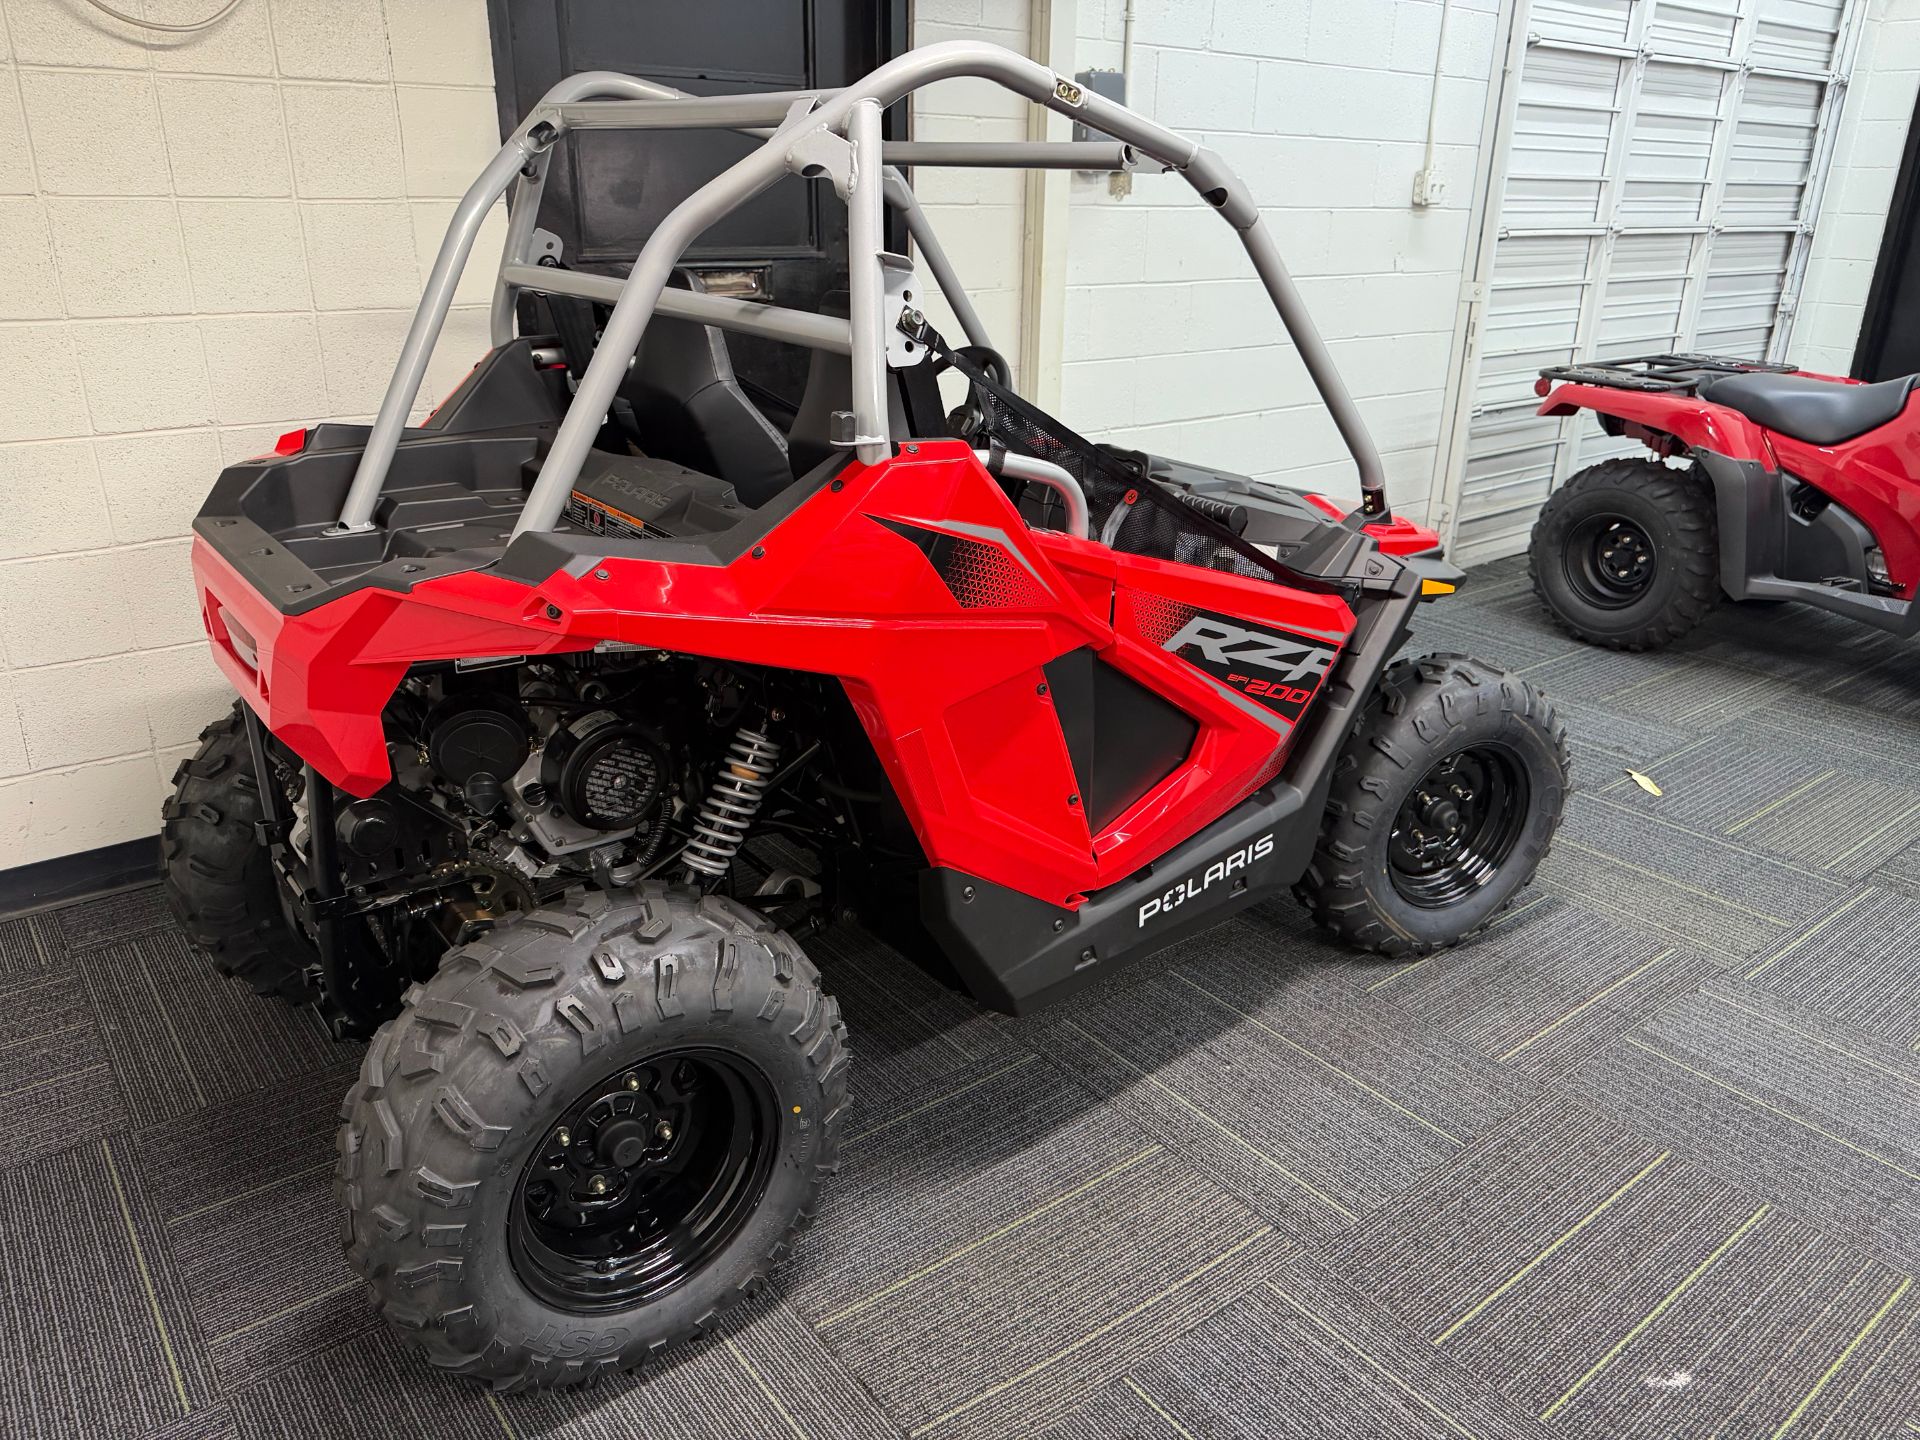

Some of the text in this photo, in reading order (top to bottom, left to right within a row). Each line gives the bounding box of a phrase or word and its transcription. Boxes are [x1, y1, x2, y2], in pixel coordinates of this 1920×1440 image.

[602, 472, 672, 510] POLARIS
[1227, 673, 1311, 704] EFI 200
[1138, 833, 1274, 928] POLARIS
[520, 1323, 631, 1358] CST
